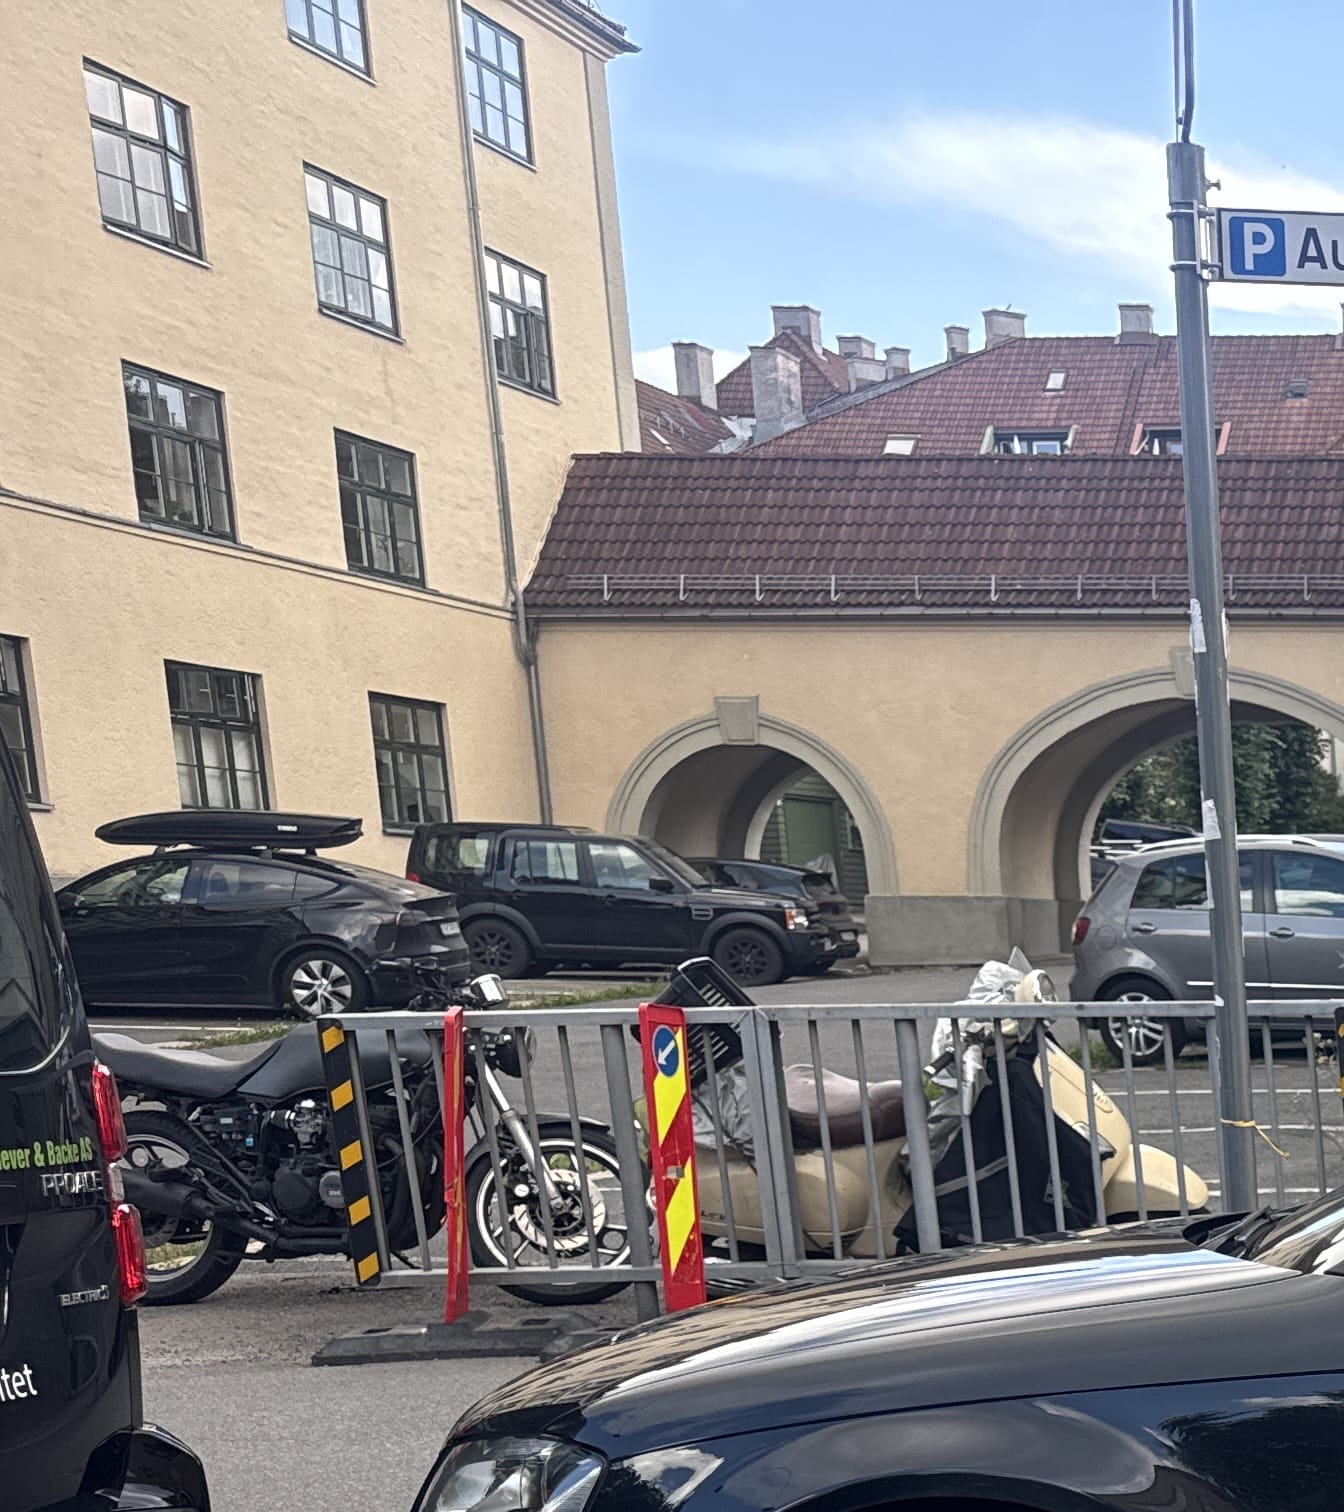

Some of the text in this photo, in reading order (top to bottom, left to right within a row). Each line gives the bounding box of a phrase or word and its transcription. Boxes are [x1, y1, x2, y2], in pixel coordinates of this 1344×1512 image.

[1243, 221, 1275, 271] P
[33, 1141, 46, 1168] &
[46, 1139, 80, 1166] Backe
[79, 1136, 93, 1162] AS
